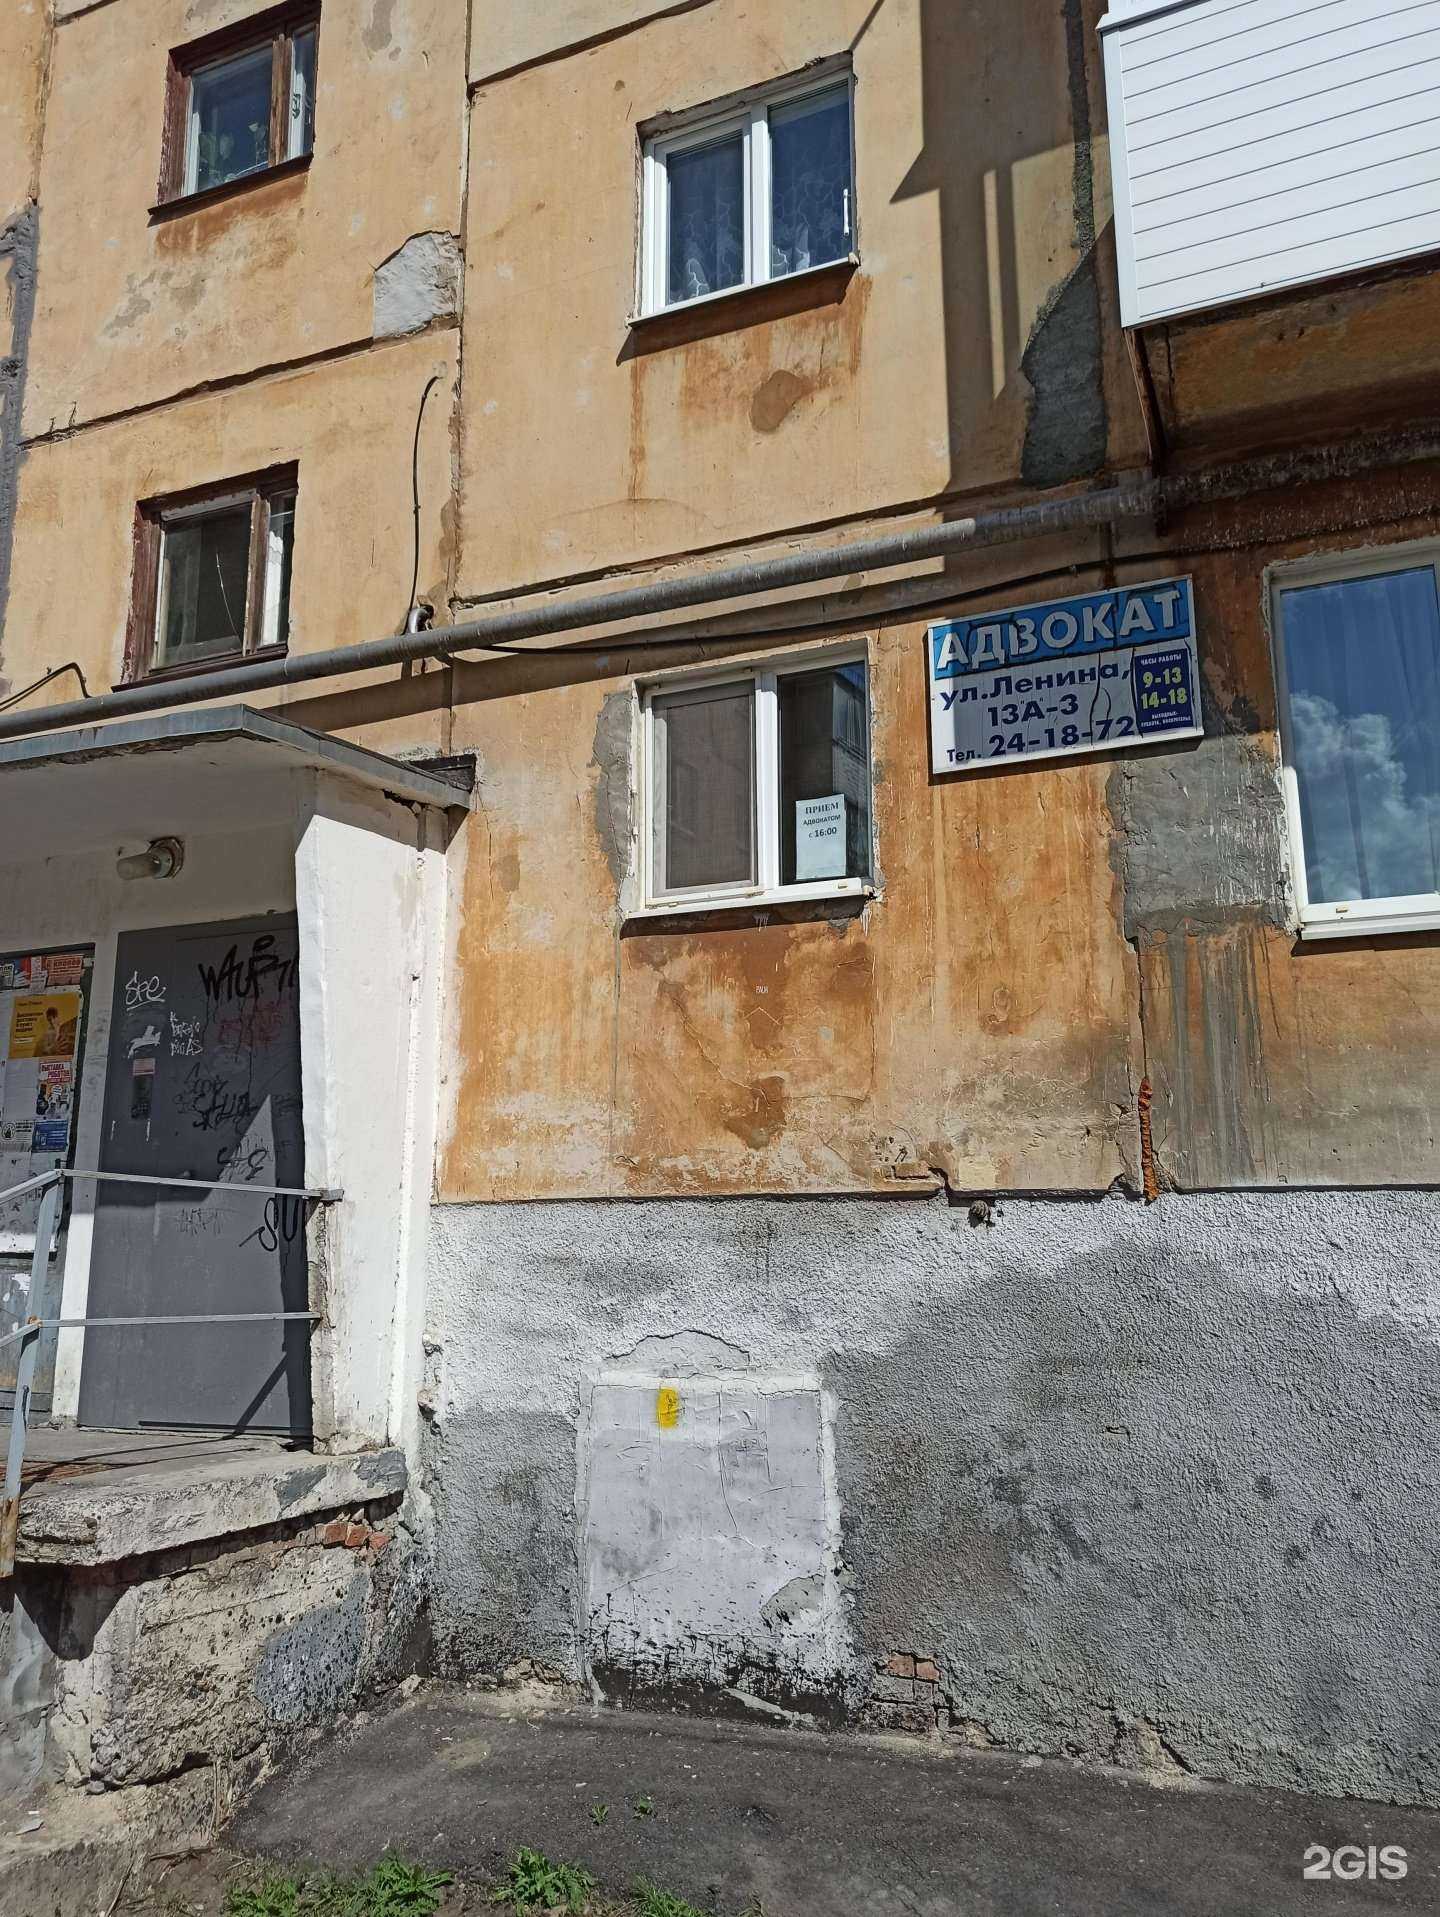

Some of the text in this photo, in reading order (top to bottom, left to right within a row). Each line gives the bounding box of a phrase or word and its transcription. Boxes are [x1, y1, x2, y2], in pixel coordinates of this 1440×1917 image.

[936, 589, 1181, 671] АДВОКАТ
[1140, 653, 1182, 666] ЧАСЫ РАБОТЫ
[1142, 666, 1182, 688] 9-13
[1140, 687, 1188, 709] 14-18
[946, 715, 1135, 762] Тел. 24-18-72
[805, 802, 840, 815] ПРИЕМ
[814, 826, 837, 838] 16:00
